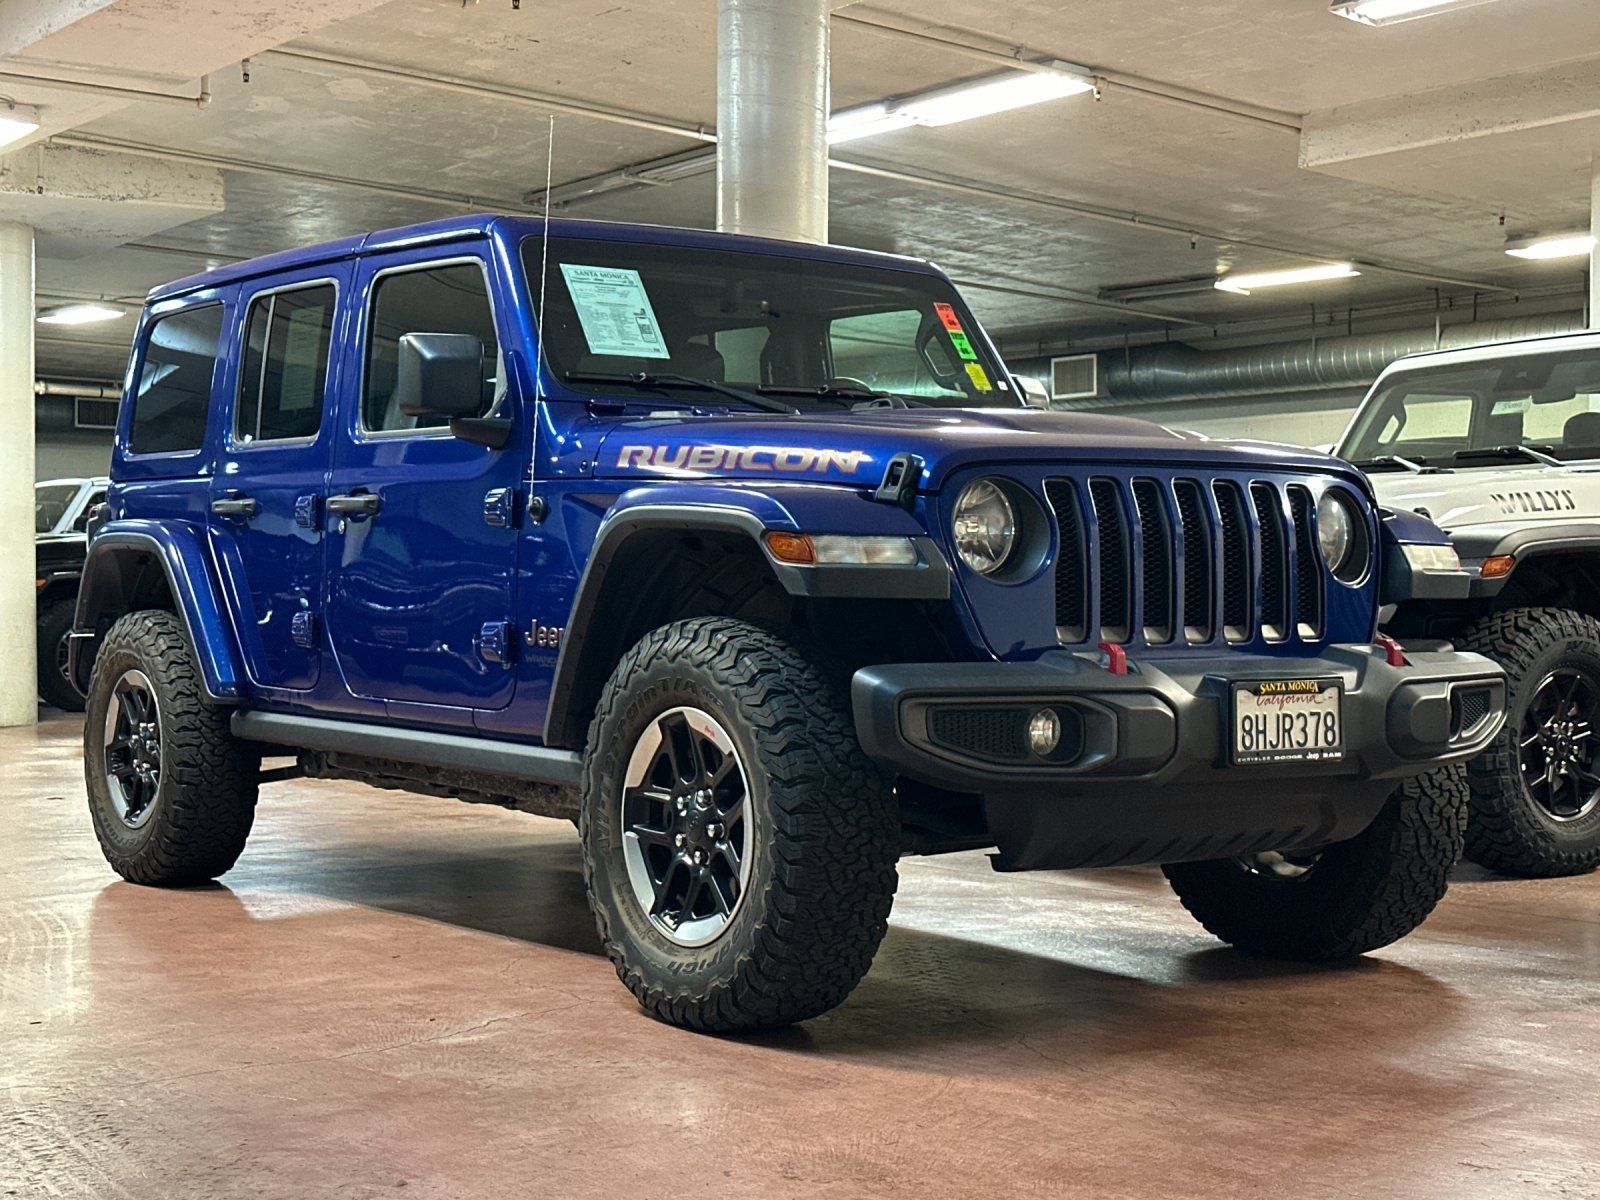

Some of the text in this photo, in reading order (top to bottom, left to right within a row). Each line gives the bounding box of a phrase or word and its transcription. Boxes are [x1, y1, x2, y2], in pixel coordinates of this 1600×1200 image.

[574, 270, 598, 278] SANTA
[600, 272, 629, 280] MONICA
[616, 445, 863, 474] RUBICON
[1490, 489, 1575, 514] WILLYS
[1260, 681, 1319, 694] SANTA MONICA
[1241, 711, 1336, 751] 8HJR378
